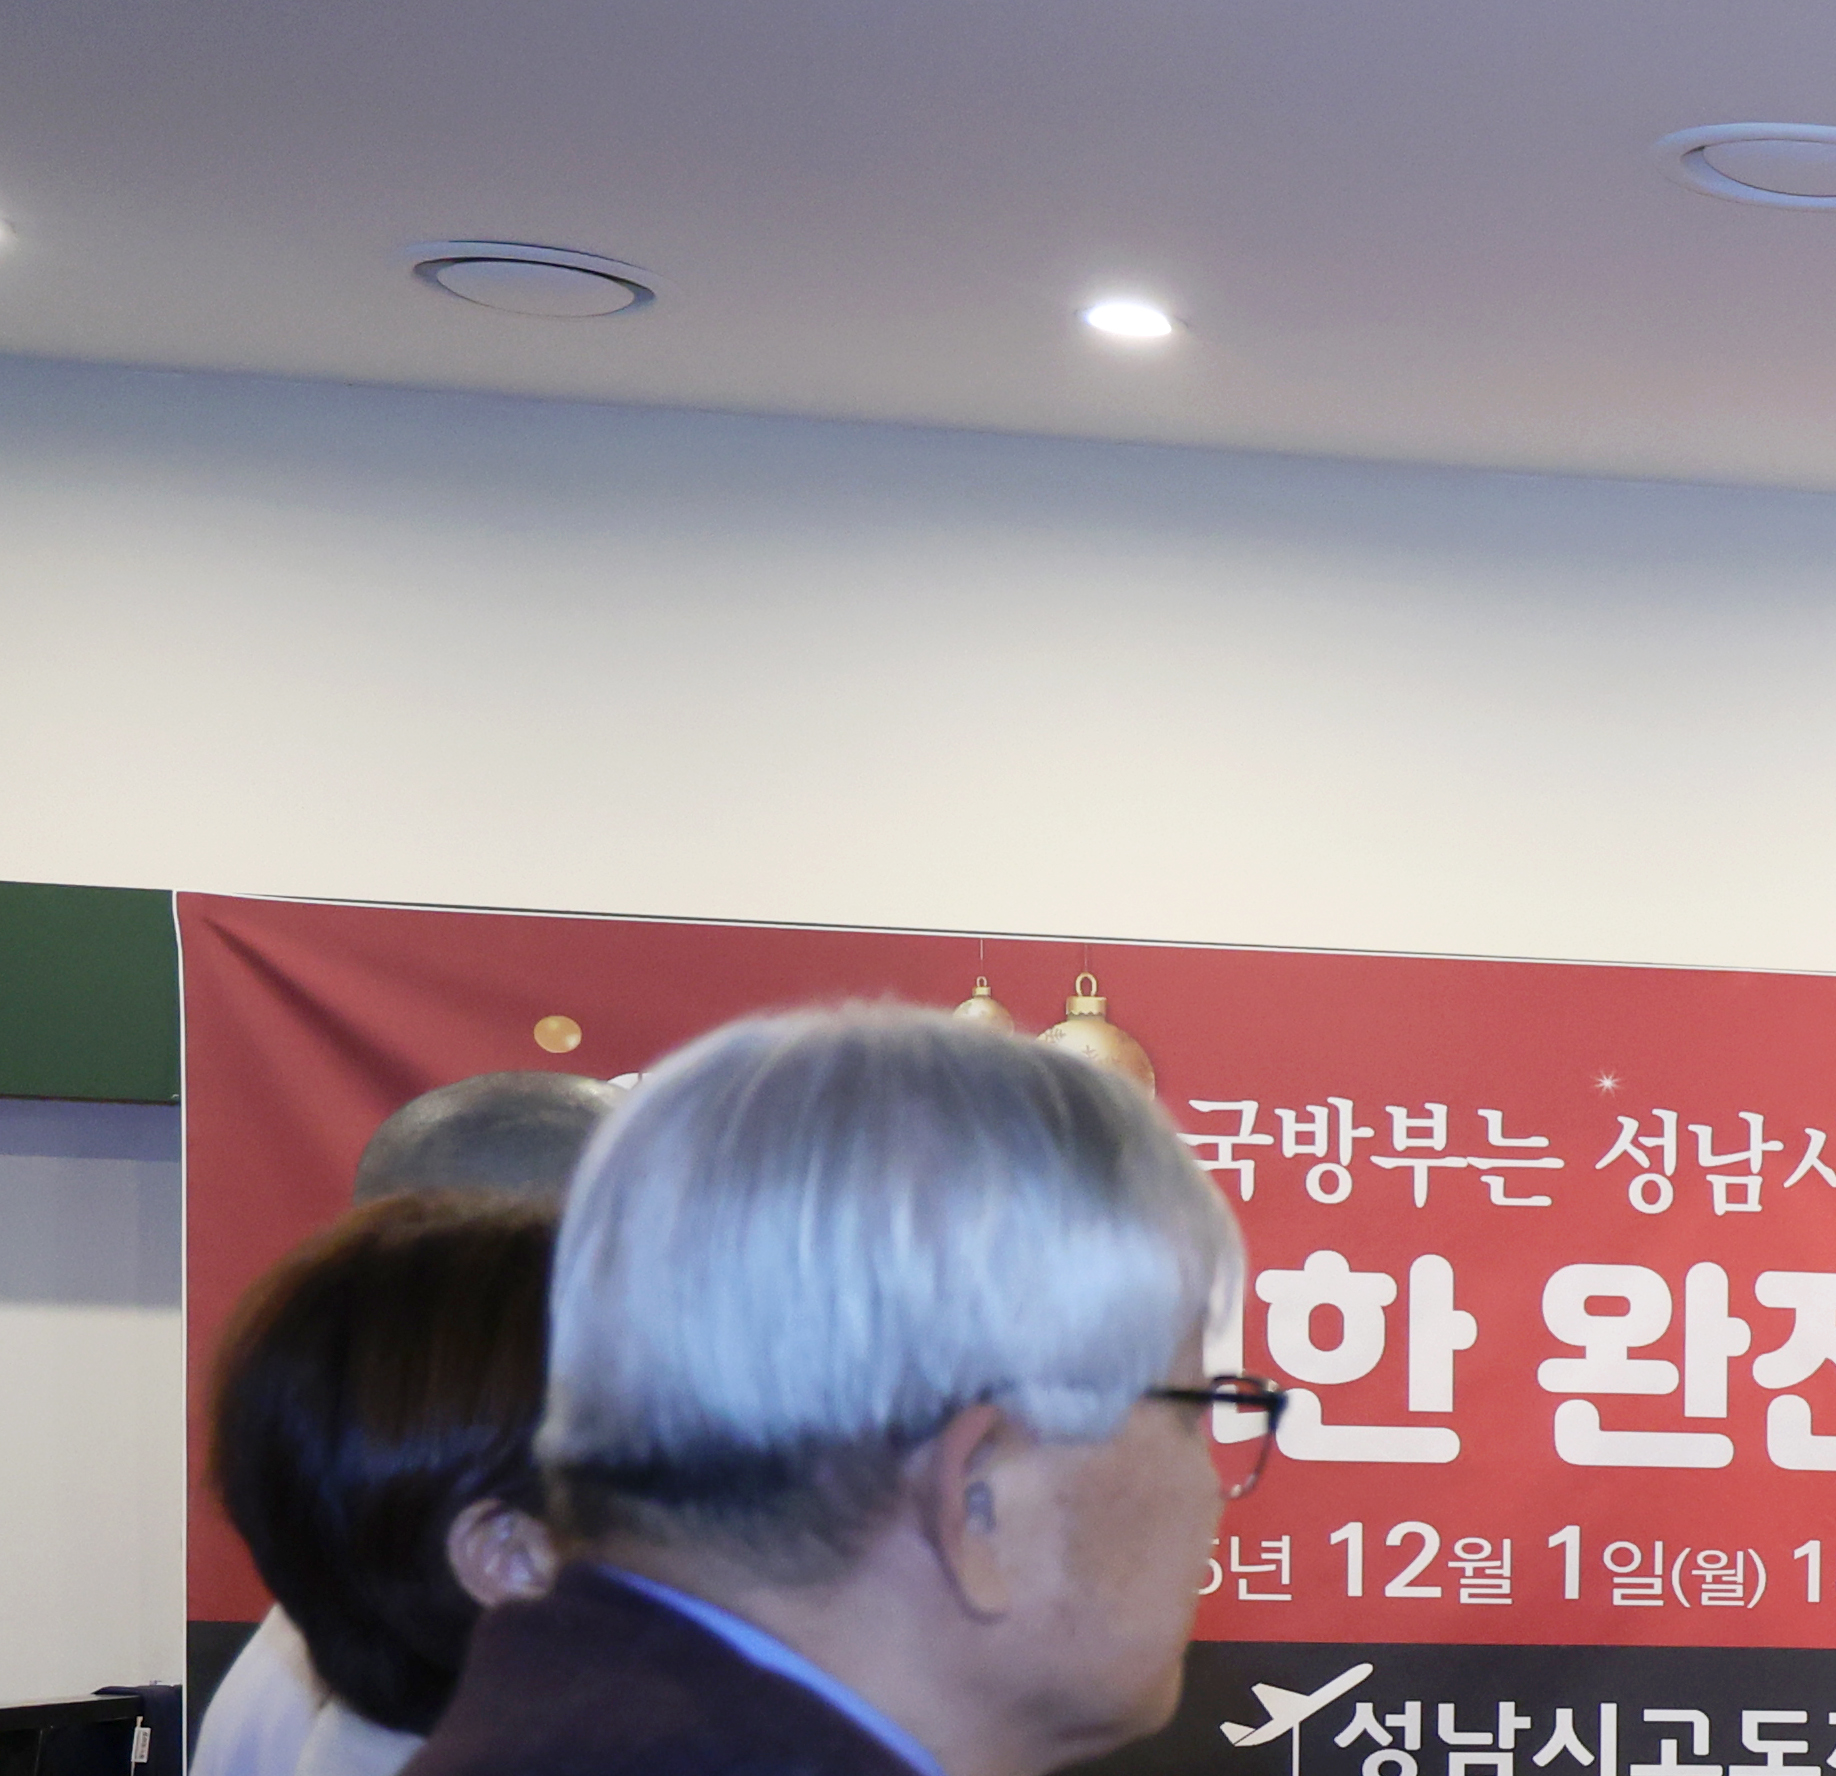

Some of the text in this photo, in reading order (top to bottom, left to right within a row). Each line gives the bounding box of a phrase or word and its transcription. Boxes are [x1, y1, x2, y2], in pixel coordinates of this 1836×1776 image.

[1177, 1095, 1566, 1212] 국방부는
[1329, 1520, 1513, 1605] 12월
[1547, 1524, 1767, 1610] 1일(월)
